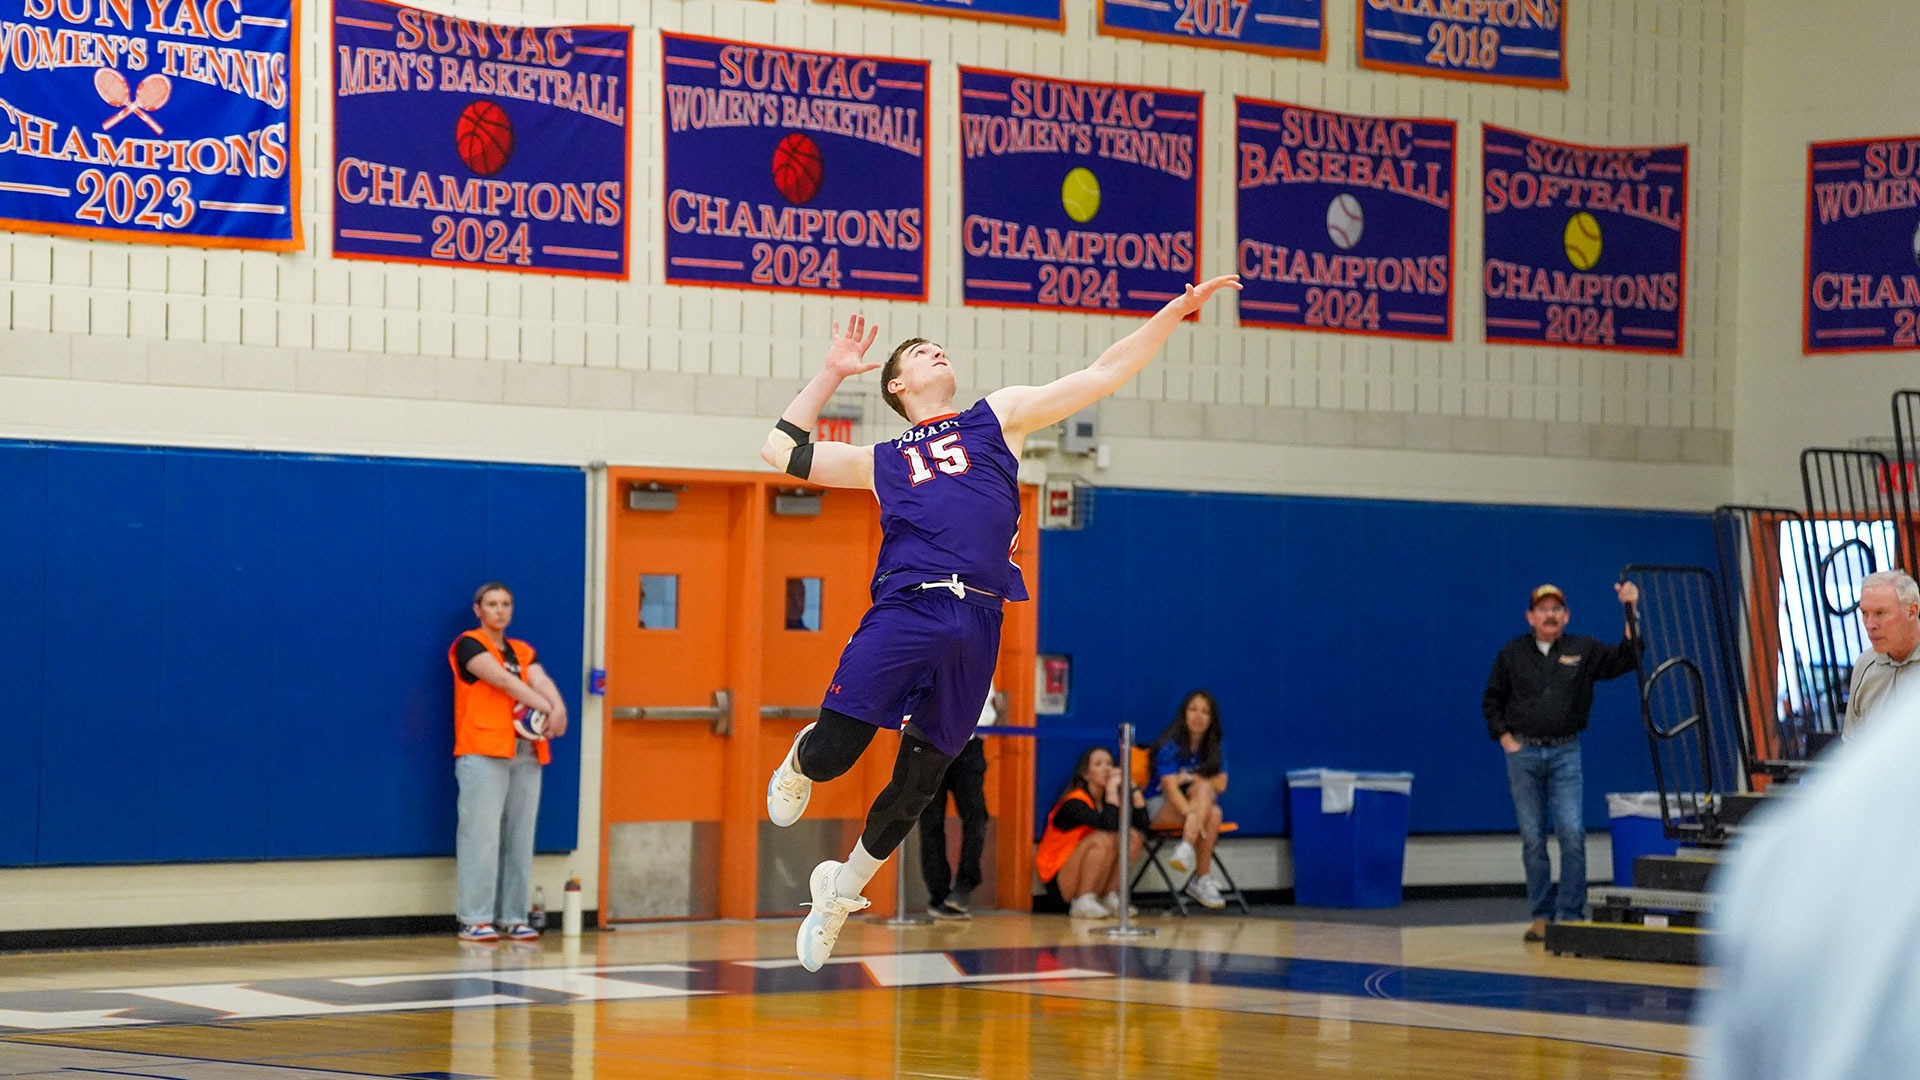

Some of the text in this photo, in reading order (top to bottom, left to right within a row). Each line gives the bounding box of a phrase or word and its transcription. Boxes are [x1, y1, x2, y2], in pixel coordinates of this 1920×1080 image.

[397, 9, 573, 67] SUNYAC
[1174, 0, 1250, 38] 2017
[1425, 21, 1500, 70] 2018
[158, 41, 286, 110] TENNIS
[339, 46, 624, 126] MEN'S BASKETBALL
[719, 45, 877, 100] SUNYAC
[667, 84, 921, 158] WOMEN'S BASKETBALL
[1011, 77, 1154, 129] SUNYAC
[962, 113, 1193, 180] WOMEN'S TENNIS
[1281, 108, 1414, 158] SUNYAC
[1864, 141, 1920, 180] SU
[75, 169, 195, 229] 2023
[337, 157, 621, 226] CHAMPIONS
[1239, 143, 1450, 209] BASEBALL
[1485, 169, 1682, 231] SOFTBALL
[431, 215, 532, 265] 2024
[668, 189, 921, 250] CHAMPIONS
[964, 214, 1194, 273] CHAMPIONS
[751, 242, 842, 289] 2024
[1038, 265, 1121, 308] 2024
[1239, 238, 1449, 296] CHAMPIONS
[1484, 258, 1679, 313] CHAMPIONS
[1305, 287, 1381, 330] 2024
[1545, 305, 1616, 344] 2024
[900, 431, 972, 488] 15
